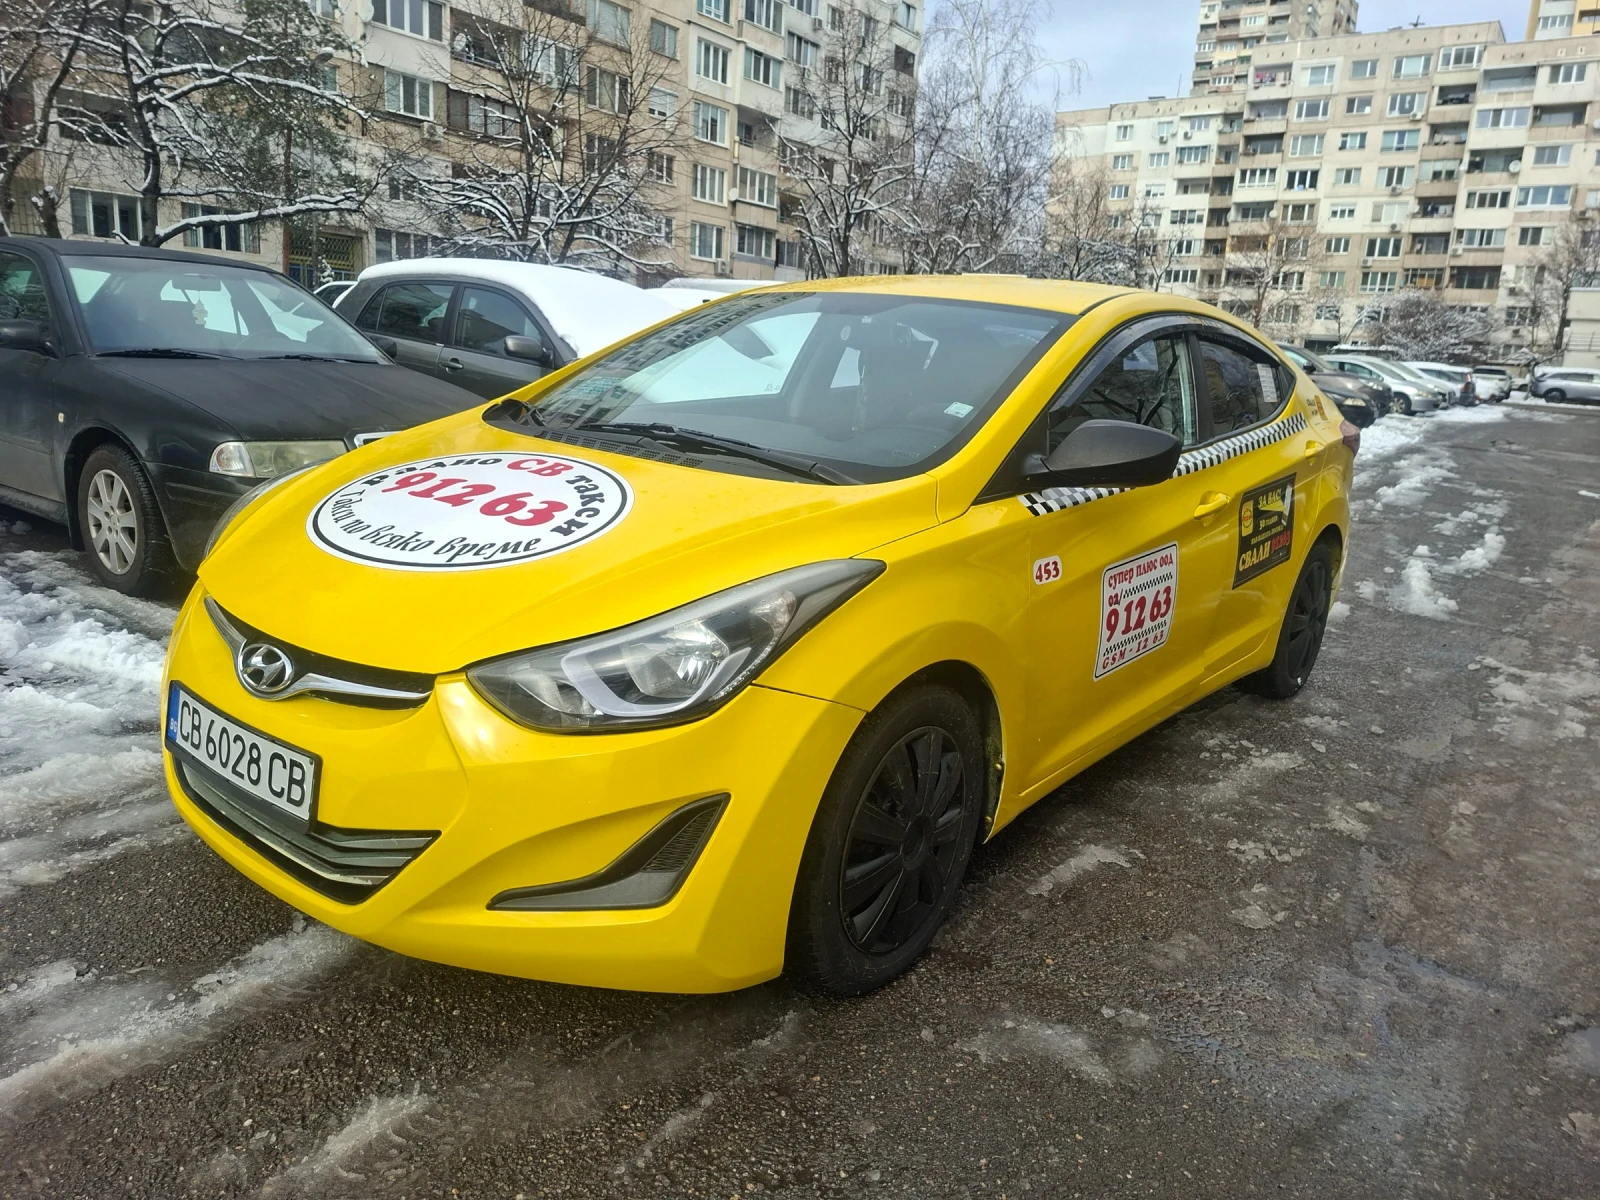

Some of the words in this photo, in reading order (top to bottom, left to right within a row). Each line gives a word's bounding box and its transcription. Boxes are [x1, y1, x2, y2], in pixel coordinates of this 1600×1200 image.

[339, 519, 371, 534] по
[359, 525, 435, 552] всяко
[436, 537, 541, 562] време
[1238, 540, 1271, 572] СВАЛИ
[1035, 560, 1060, 583] 453
[1102, 648, 1126, 670] GSM
[169, 717, 178, 733] BG
